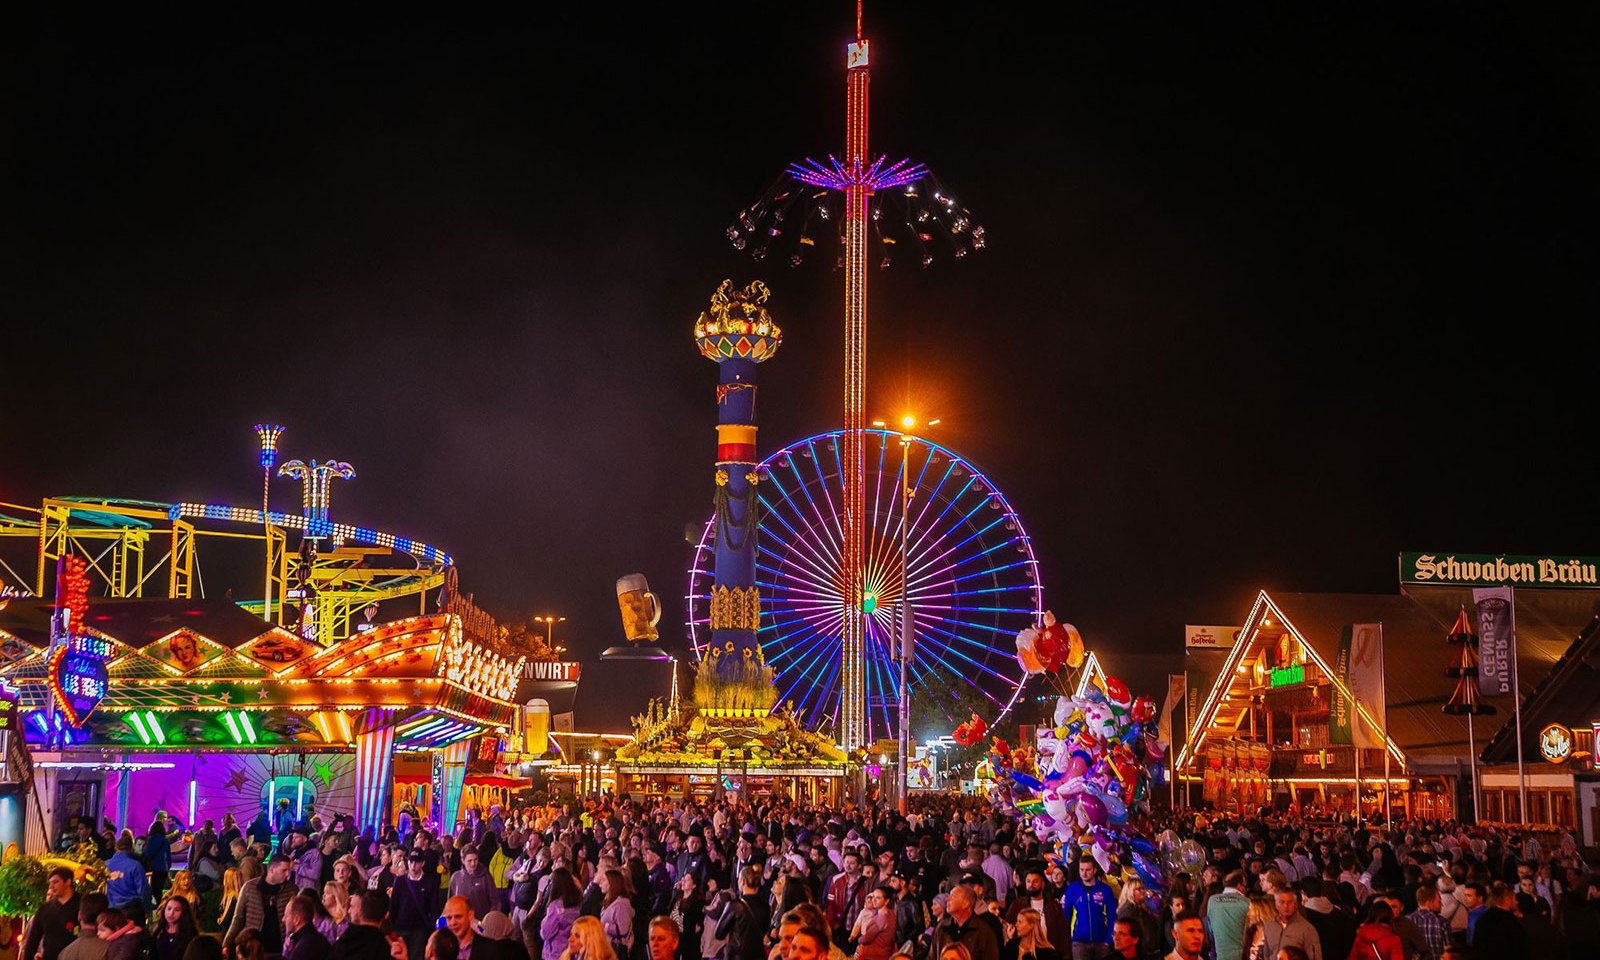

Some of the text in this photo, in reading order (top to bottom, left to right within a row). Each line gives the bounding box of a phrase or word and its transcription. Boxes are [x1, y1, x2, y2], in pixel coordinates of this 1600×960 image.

[1414, 555, 1598, 583] Schwaben Bräu
[521, 662, 571, 680] NWIRT
